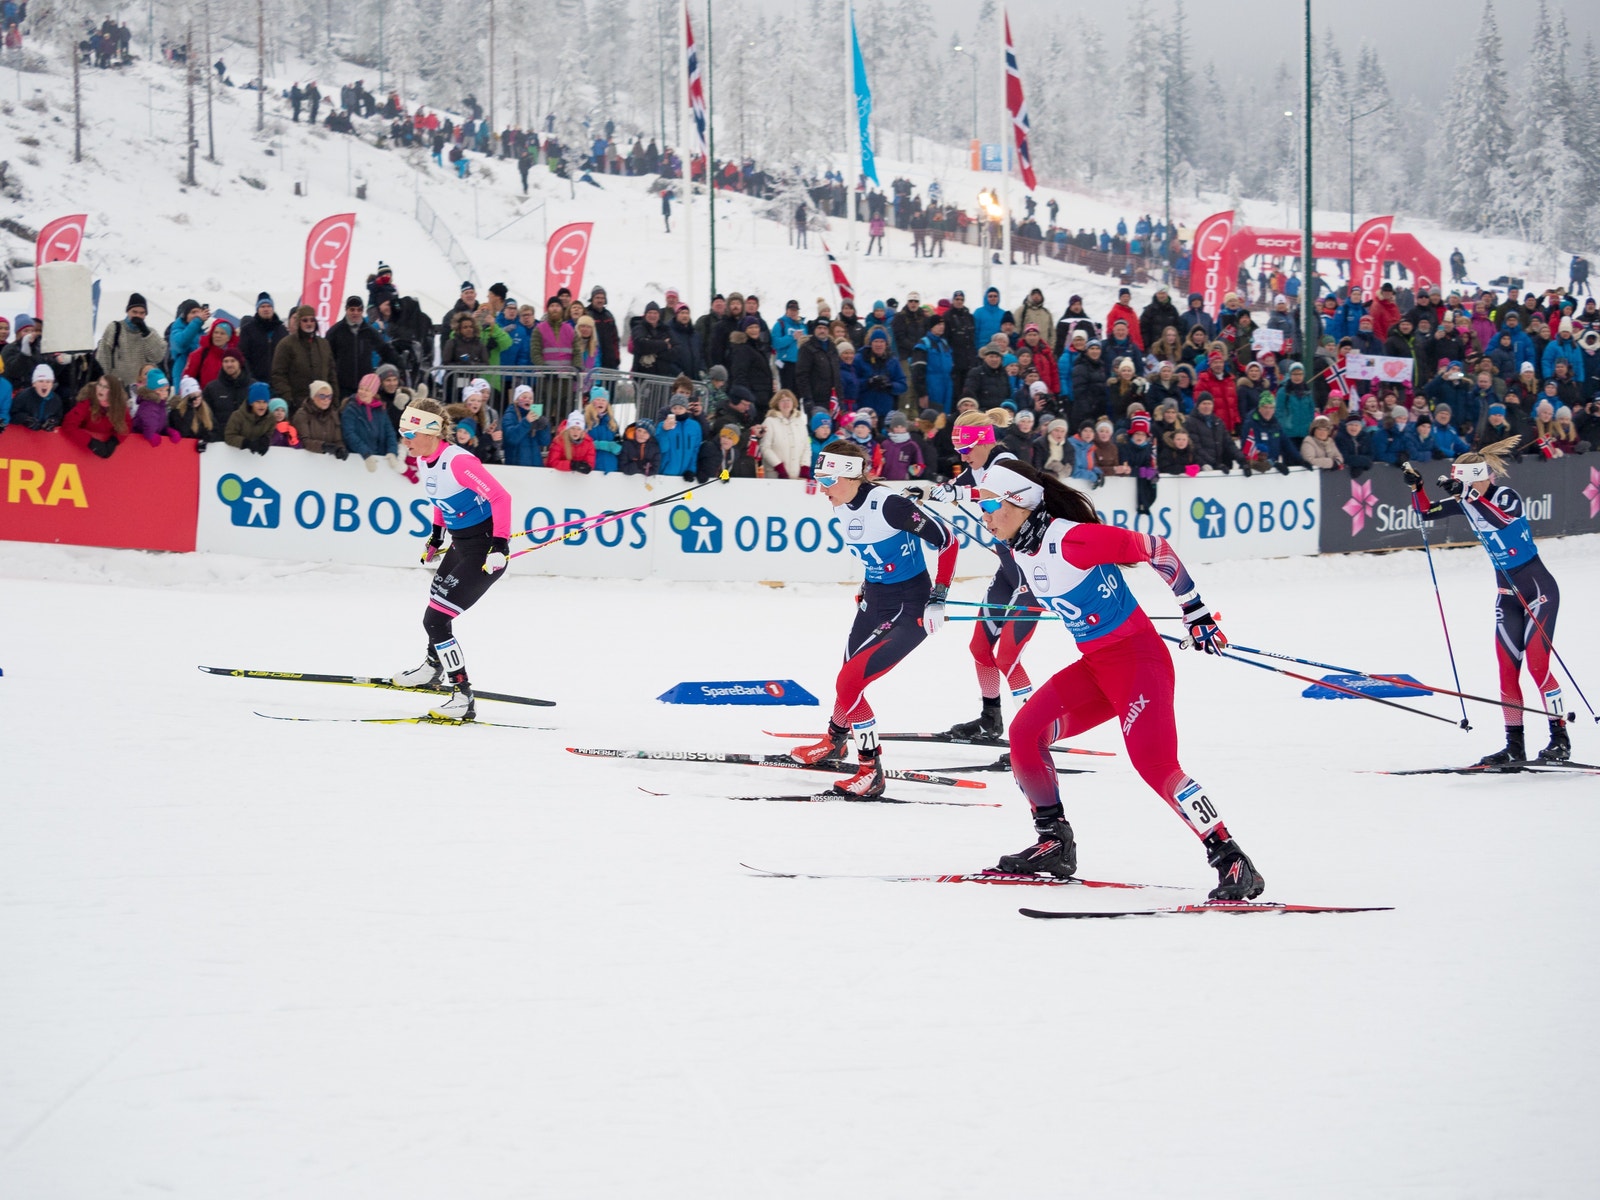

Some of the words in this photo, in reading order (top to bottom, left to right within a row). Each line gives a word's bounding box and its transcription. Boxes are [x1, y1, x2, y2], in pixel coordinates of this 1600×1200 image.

[463, 469, 491, 493] noname
[294, 490, 433, 538] OBOS
[1234, 498, 1316, 534] OBOS
[524, 506, 647, 550] OBOS
[735, 515, 844, 554] OBOS
[900, 541, 916, 557] 21
[1098, 574, 1118, 599] 30
[443, 649, 460, 669] 10
[701, 685, 767, 698] SpareBank
[768, 684, 779, 695] 1
[1551, 697, 1564, 715] 11
[860, 730, 876, 751] 21
[807, 746, 828, 757] alpina
[758, 760, 800, 769] ROSSIGNOL
[1191, 795, 1218, 824] 30
[960, 874, 1083, 885] MADSHUS
